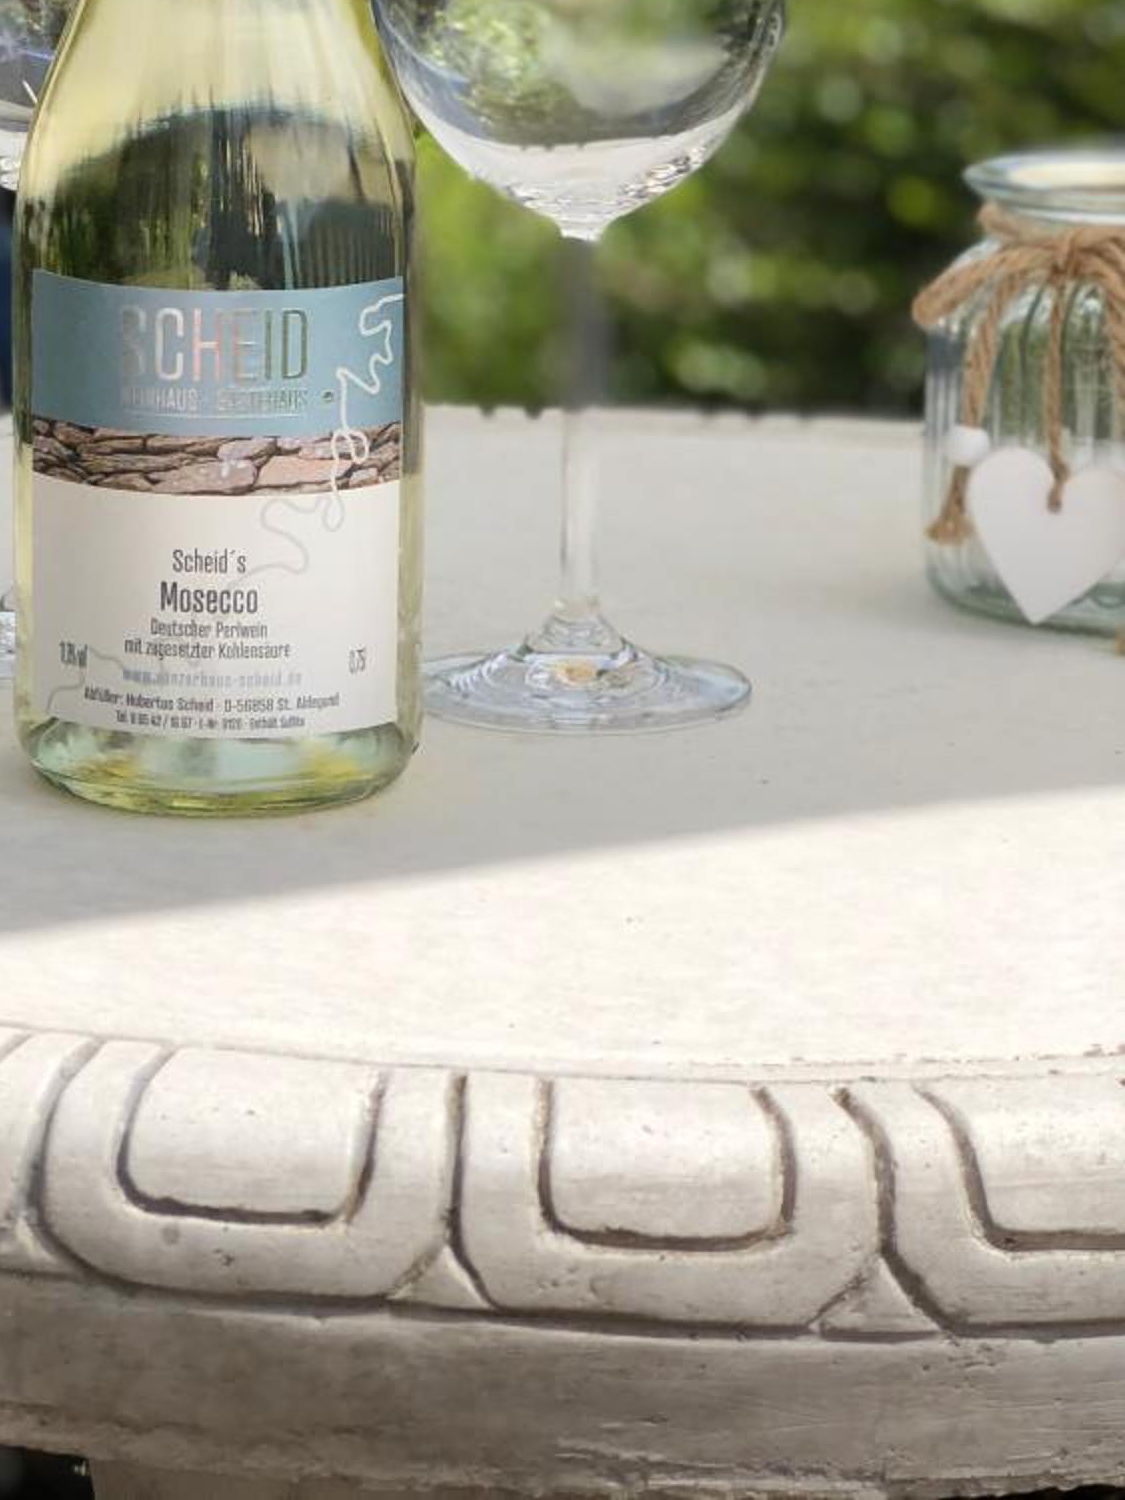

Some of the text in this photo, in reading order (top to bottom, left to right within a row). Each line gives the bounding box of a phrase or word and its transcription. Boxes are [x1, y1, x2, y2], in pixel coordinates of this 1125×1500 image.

[121, 307, 309, 381] SCHEID
[160, 581, 258, 614] Mosecco
[150, 618, 268, 639] Deutscher Perlwein
[124, 639, 142, 654] mit
[143, 640, 215, 660] zugesetzter
[126, 693, 174, 711] Hubertus
[177, 697, 214, 712] Scheid
